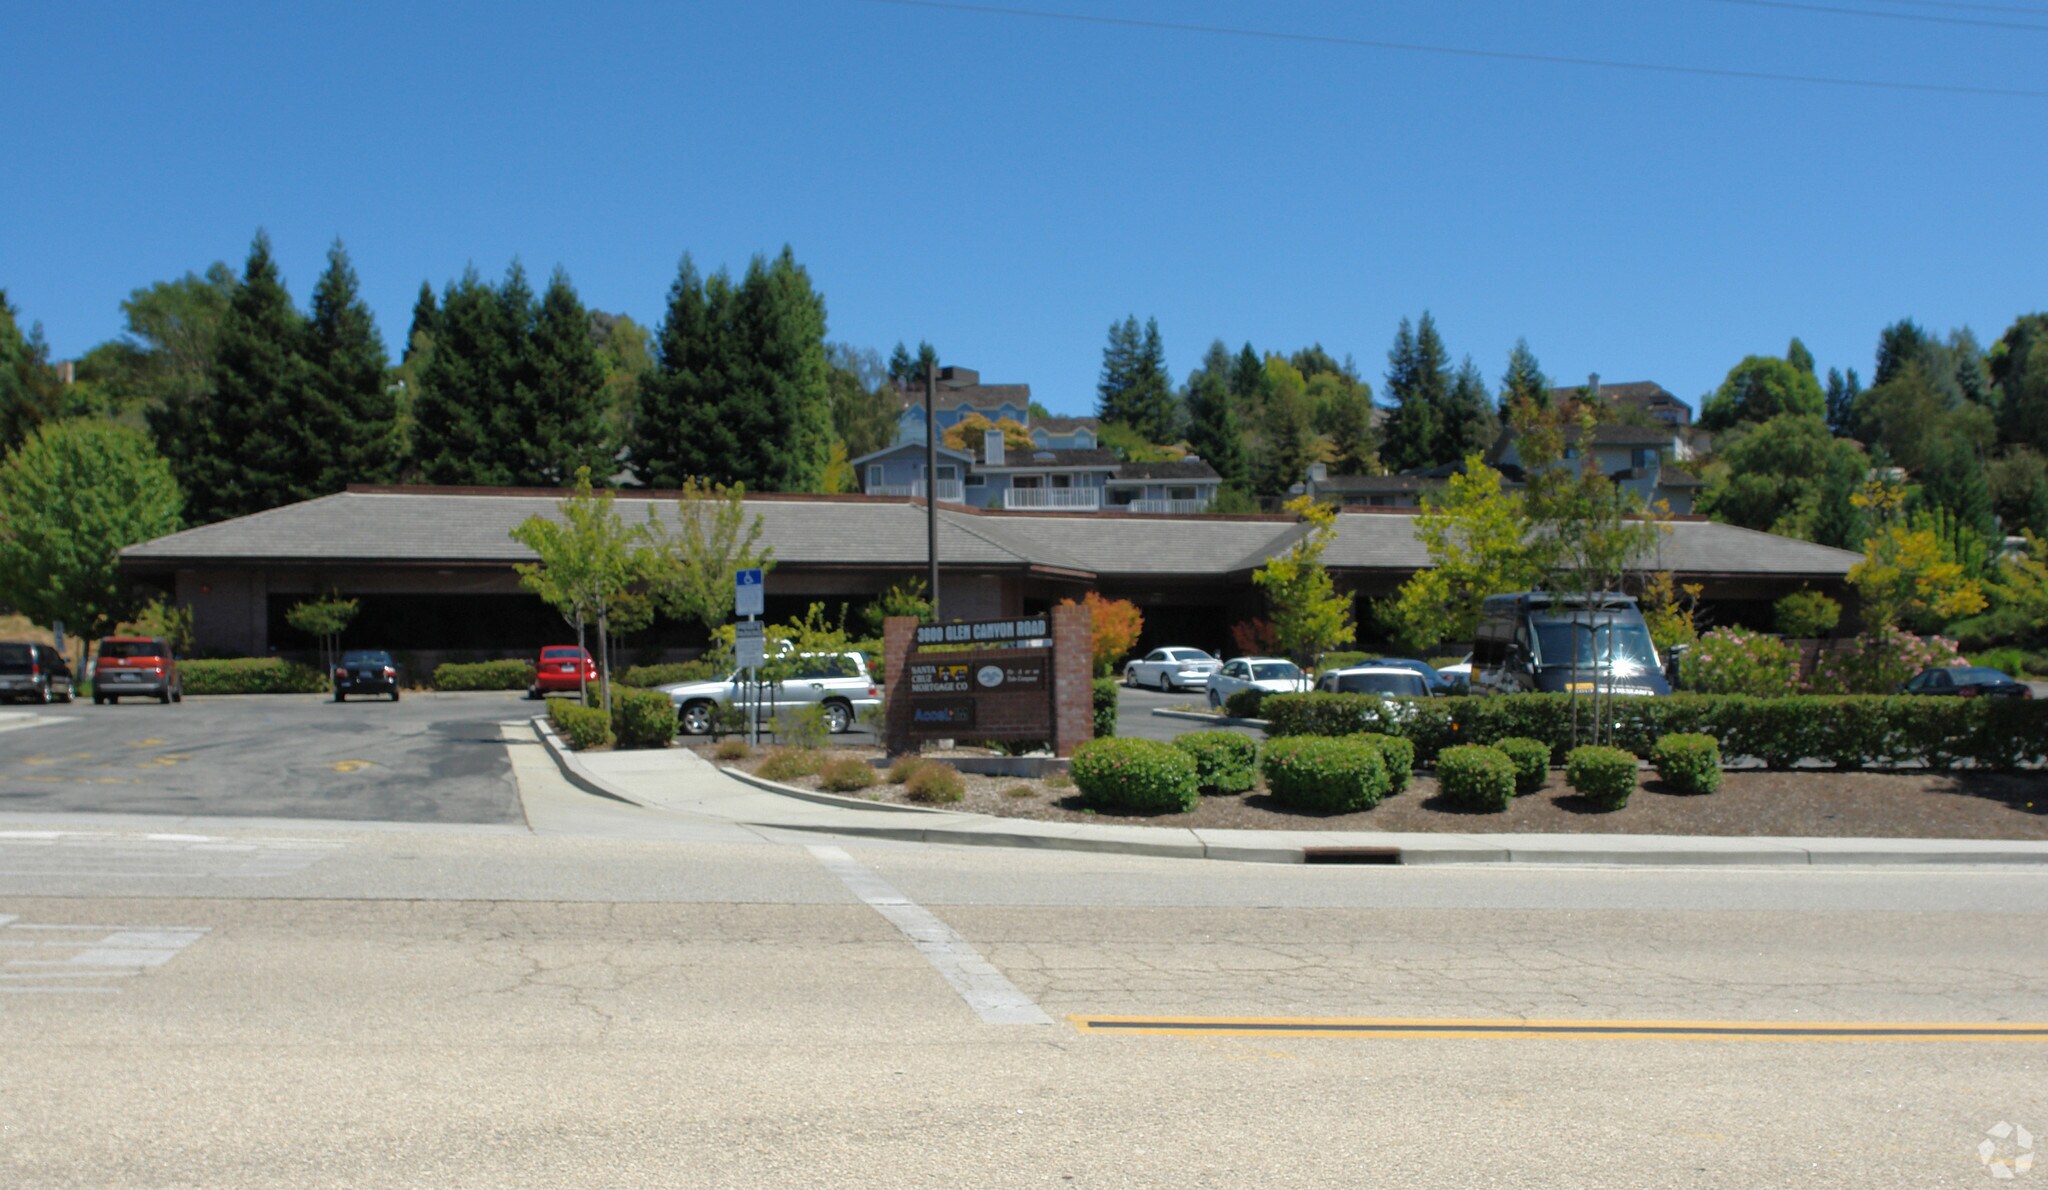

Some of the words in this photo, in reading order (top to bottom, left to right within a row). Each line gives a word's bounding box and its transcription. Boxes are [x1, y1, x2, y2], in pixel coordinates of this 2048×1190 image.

[945, 624, 971, 640] GLEN
[973, 621, 1014, 639] CANYON
[1016, 620, 1046, 636] ROAD
[911, 665, 936, 674] SANTA
[911, 674, 932, 682] CRUZ
[911, 682, 954, 692] MORTGAGE
[955, 682, 968, 691] CO
